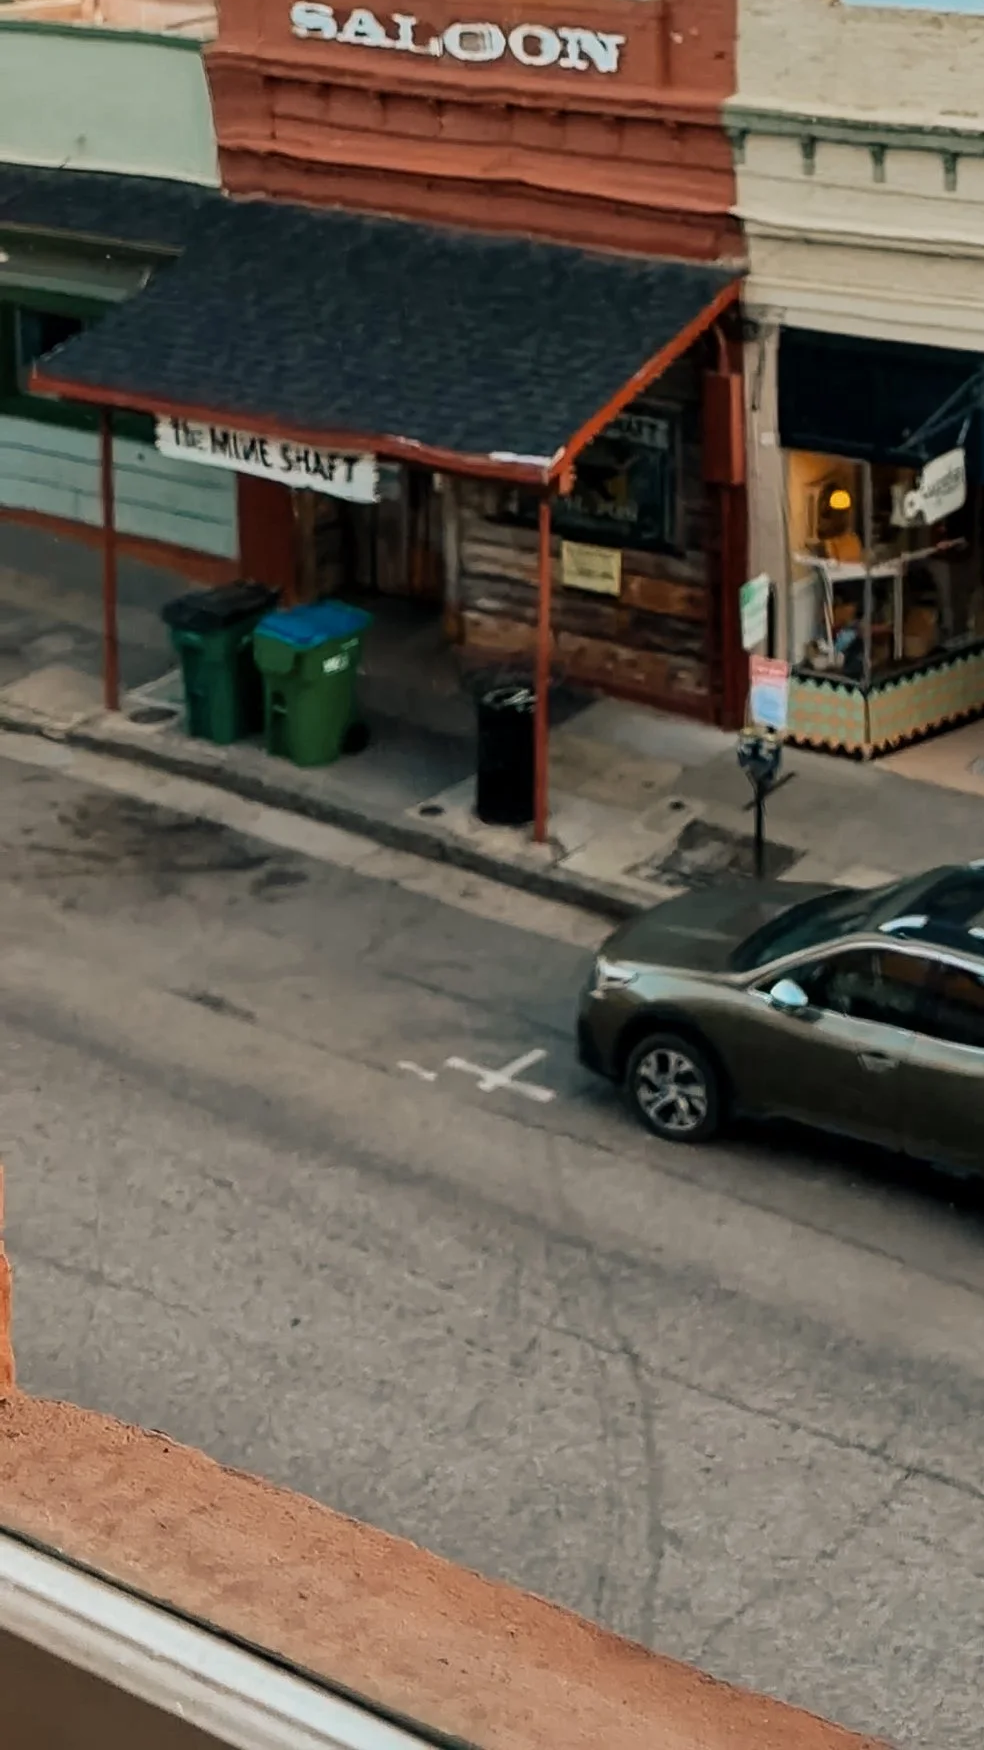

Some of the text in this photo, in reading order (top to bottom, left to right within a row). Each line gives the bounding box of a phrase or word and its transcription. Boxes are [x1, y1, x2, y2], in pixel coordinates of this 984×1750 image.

[290, 0, 626, 73] SALOON
[209, 427, 271, 467] MINE
[280, 443, 360, 482] SHAFT
